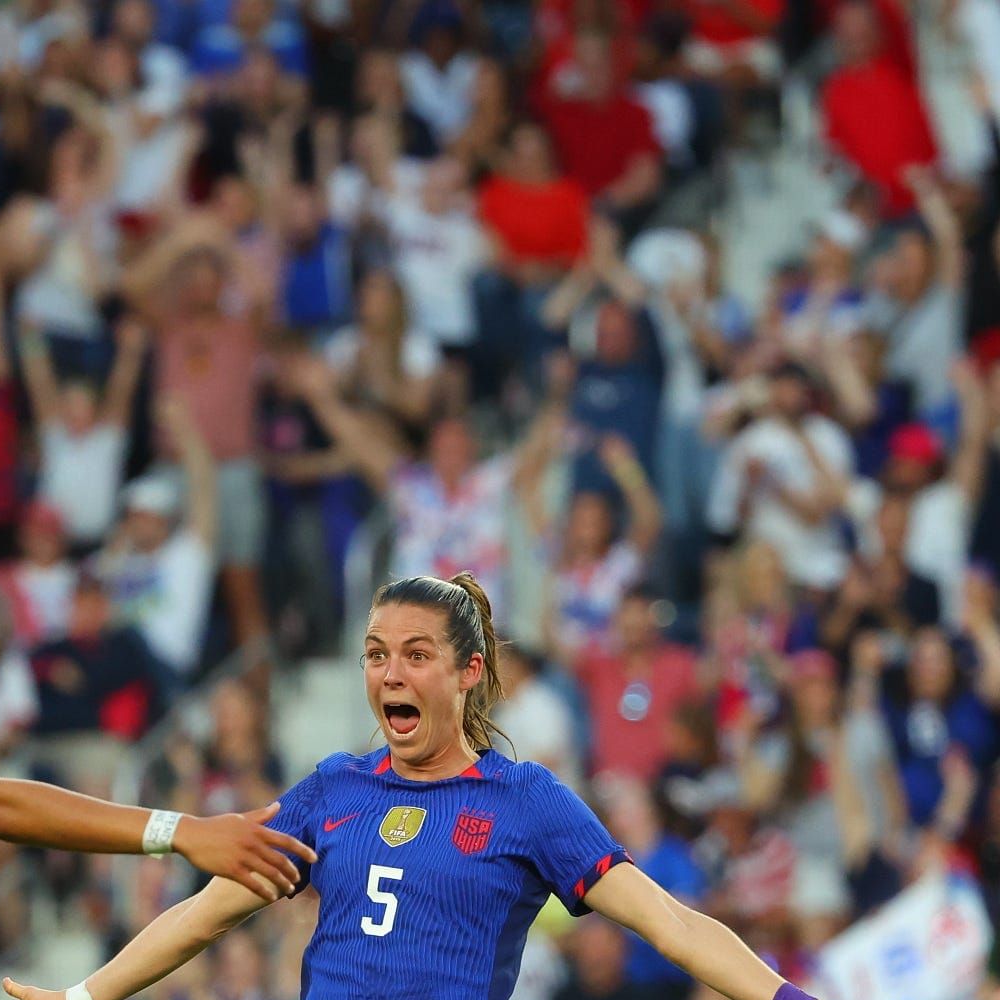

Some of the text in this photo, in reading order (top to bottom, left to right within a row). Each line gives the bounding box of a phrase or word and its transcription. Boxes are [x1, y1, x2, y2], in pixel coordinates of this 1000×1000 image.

[388, 829, 406, 838] FIFA
[458, 815, 491, 834] USA
[361, 864, 404, 936] 5
